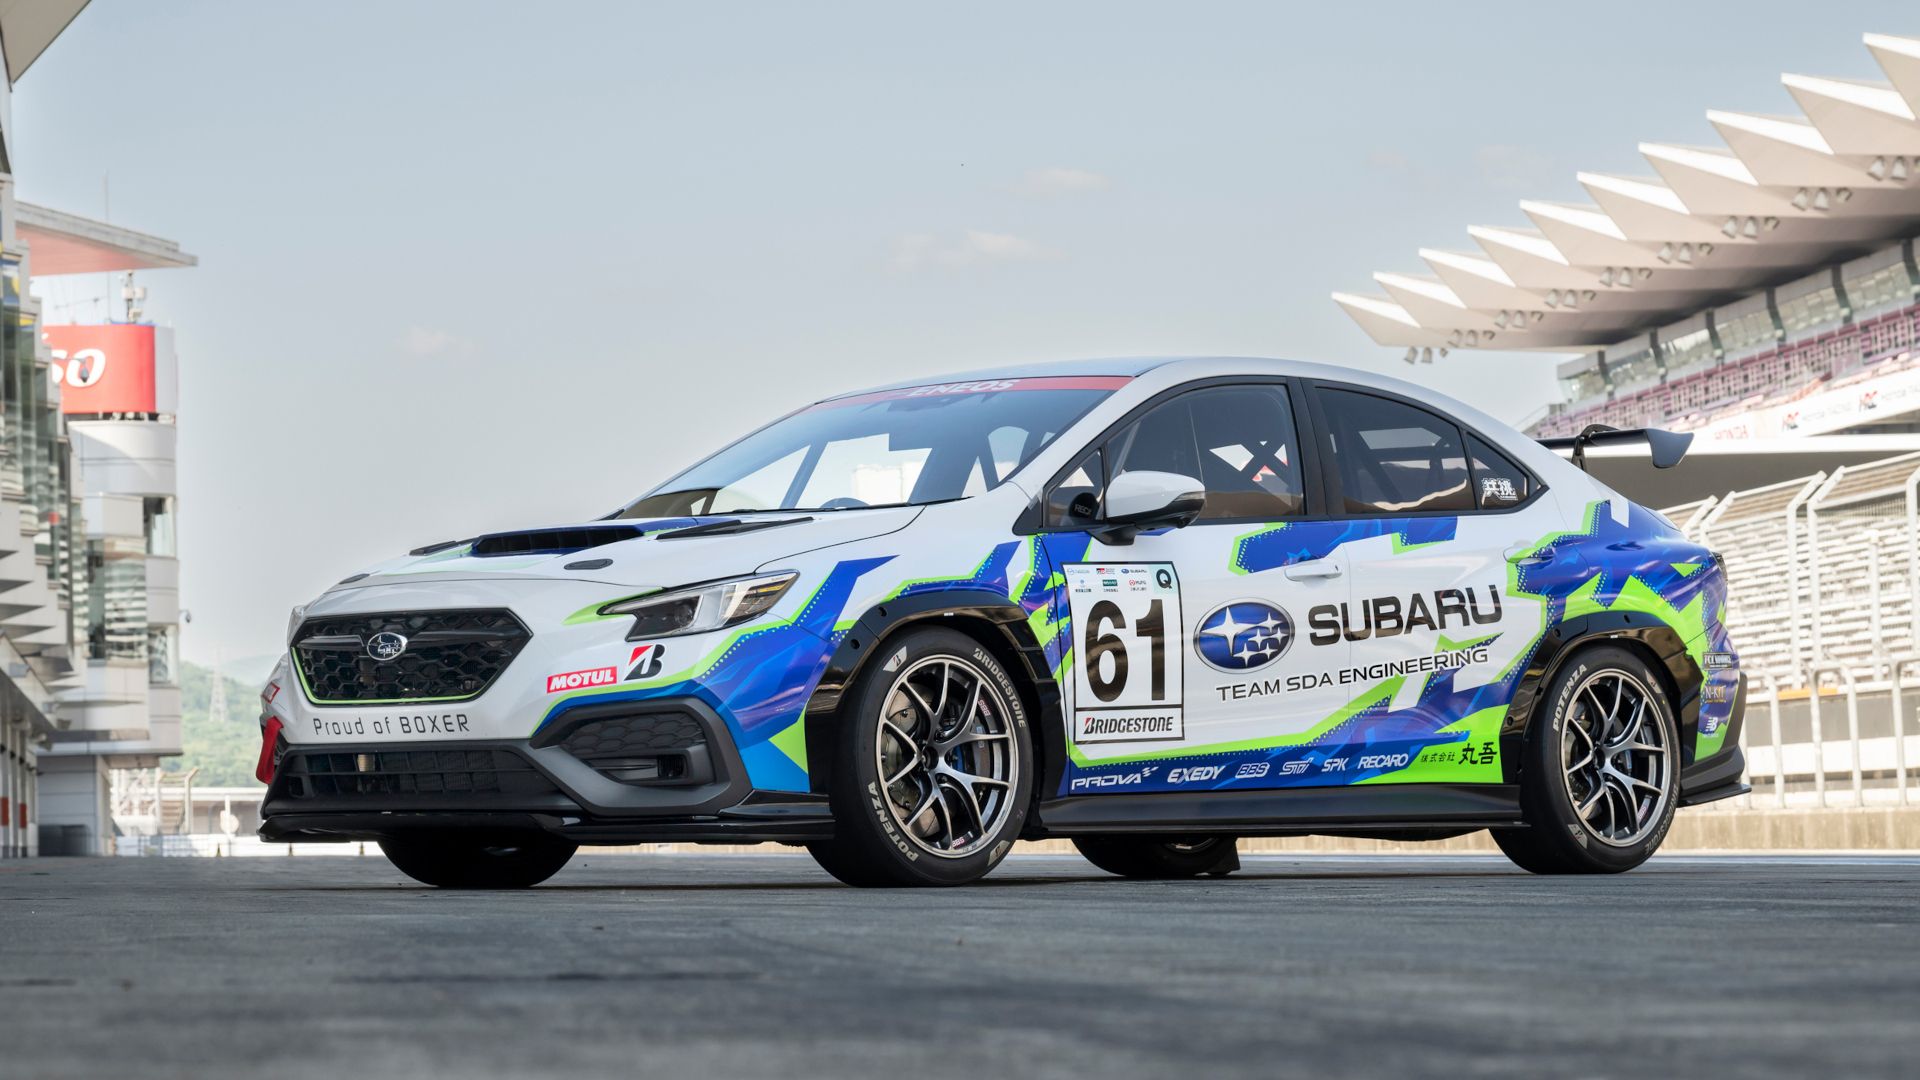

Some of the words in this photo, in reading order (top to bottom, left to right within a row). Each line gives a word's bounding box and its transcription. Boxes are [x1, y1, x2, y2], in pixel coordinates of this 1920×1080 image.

[907, 379, 1020, 397] ENEOS
[1156, 569, 1173, 589] Q
[1308, 584, 1503, 646] SUBARU
[1085, 599, 1165, 702] 61
[549, 668, 614, 691] MOTUL
[1216, 679, 1280, 701] TEAM
[1287, 673, 1333, 692] SDA
[1339, 648, 1489, 684] ENGINEERING
[973, 647, 1027, 728] BRIDGESTONE
[1552, 663, 1588, 732] POTENZA
[313, 717, 364, 735] Proud
[373, 716, 391, 734] of
[399, 714, 470, 734] BOXER
[1083, 716, 1173, 734] BRIDGESTONE
[1357, 753, 1409, 769] RECARO
[1420, 751, 1456, 763] 株式会社
[1458, 742, 1497, 765] 丸吾
[1167, 765, 1226, 784] EXEDY
[1234, 762, 1270, 779] BBS
[1321, 757, 1349, 772] SPK
[1071, 772, 1143, 790] PROVA
[867, 781, 919, 862] POTENZA
